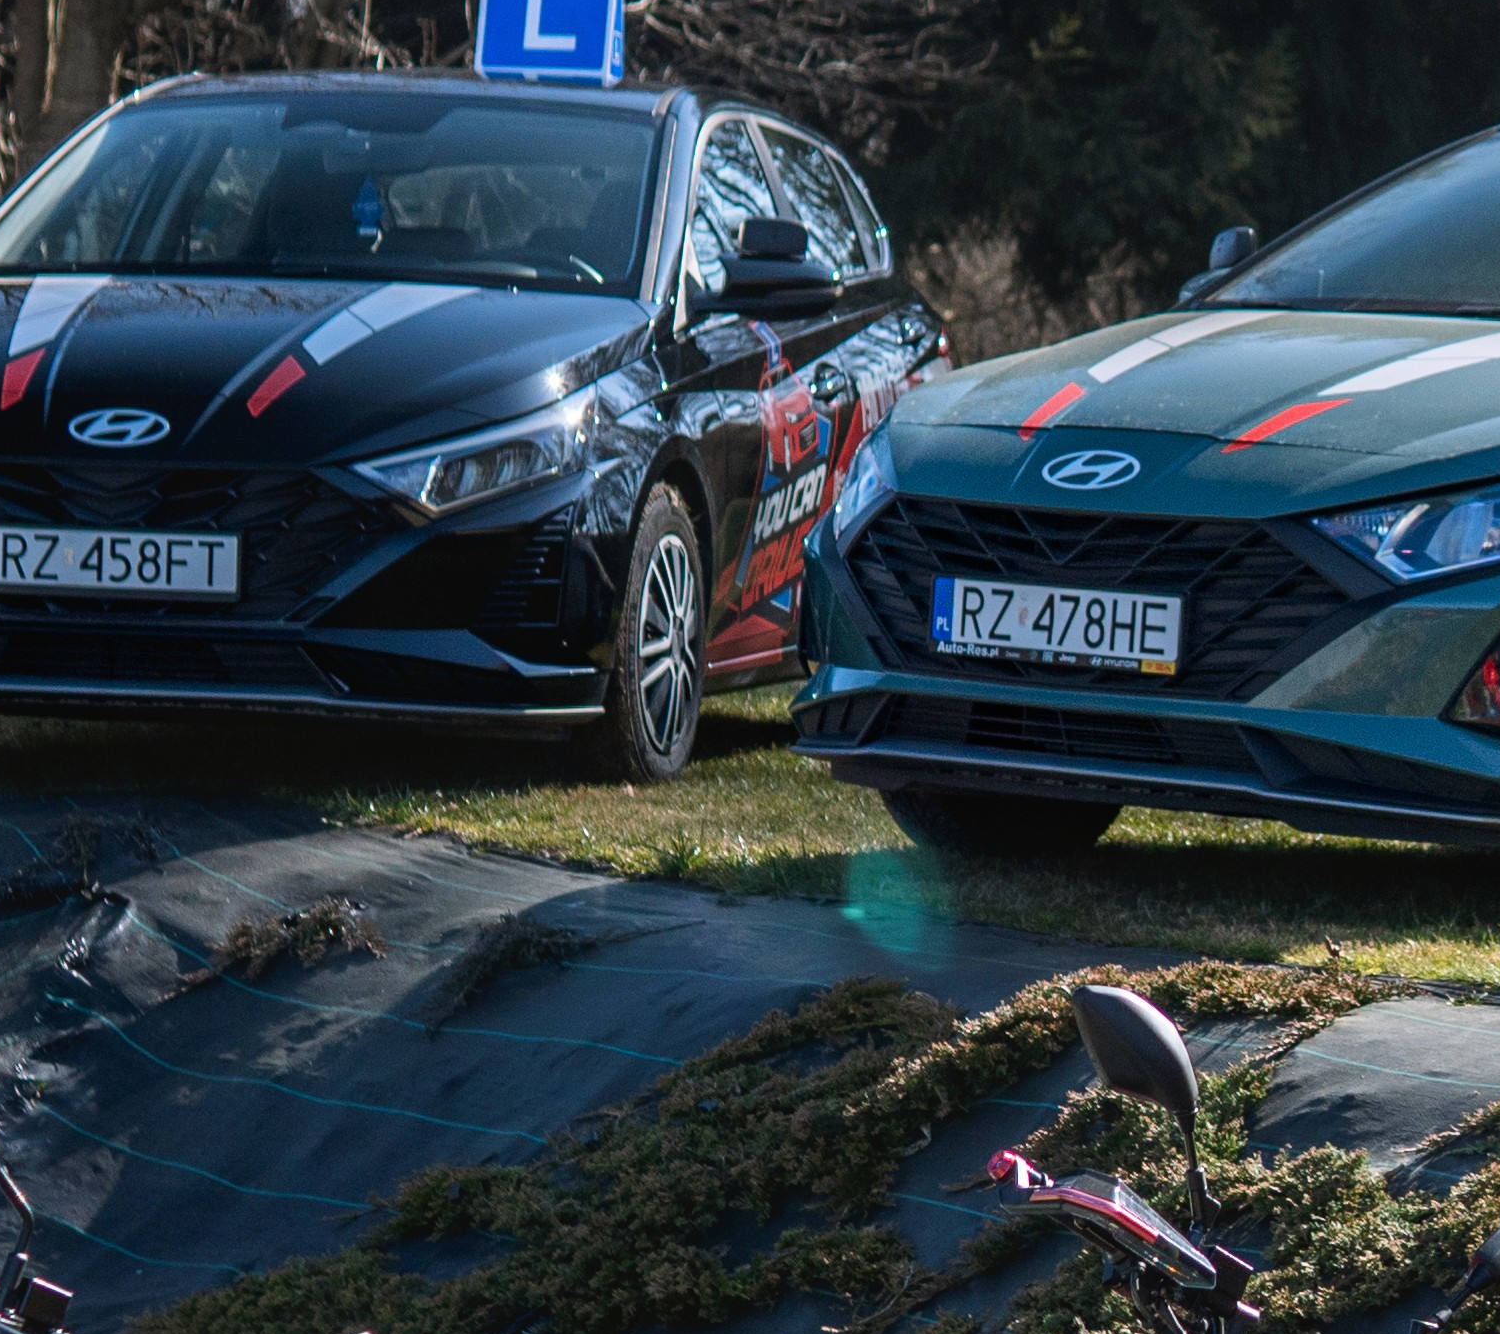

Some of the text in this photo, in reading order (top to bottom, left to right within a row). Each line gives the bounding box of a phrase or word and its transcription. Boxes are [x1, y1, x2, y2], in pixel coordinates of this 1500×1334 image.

[753, 463, 828, 545] YOU CAN
[1, 532, 225, 586] RZ 458FT
[936, 616, 950, 632] PL
[960, 585, 1168, 655] RZ 478HE
[936, 640, 1000, 658] Auto-Res.pl
